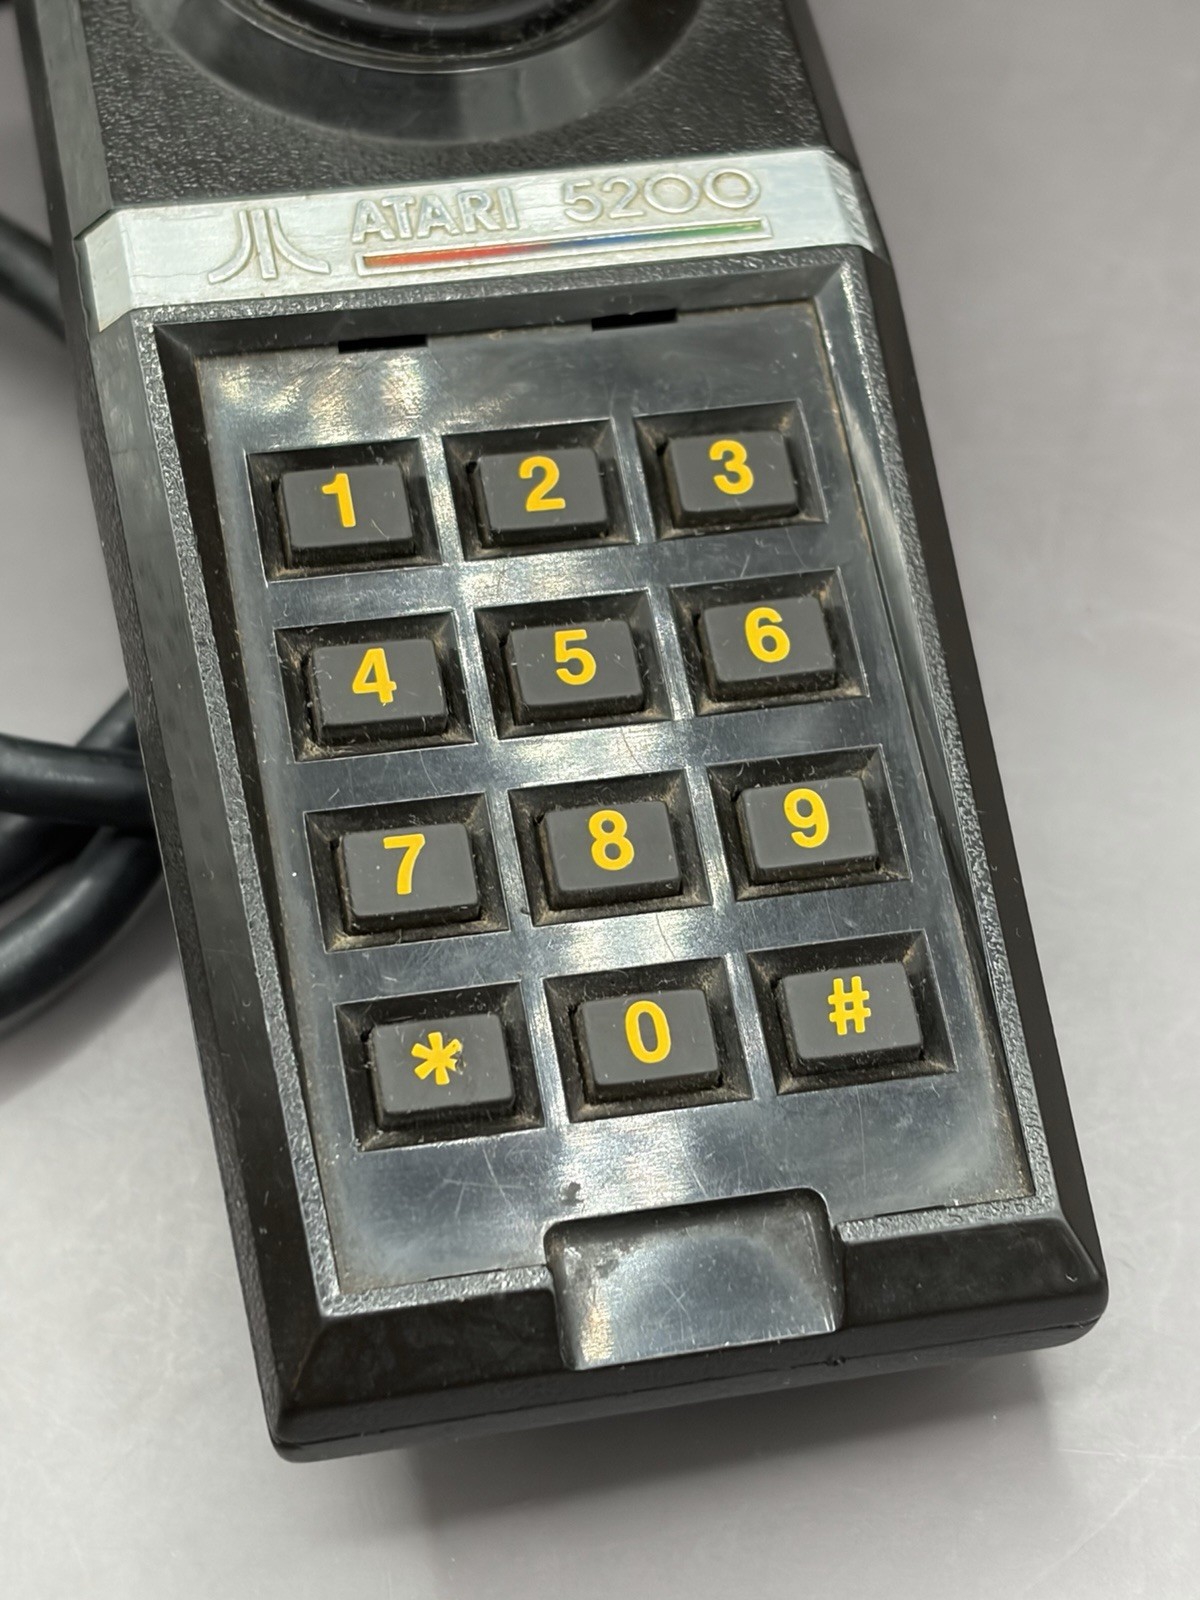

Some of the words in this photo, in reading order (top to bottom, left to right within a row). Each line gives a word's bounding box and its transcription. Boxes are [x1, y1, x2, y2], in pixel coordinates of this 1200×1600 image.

[352, 188, 519, 244] ATARI
[562, 168, 761, 222] 5200
[518, 455, 564, 511] 2
[708, 439, 752, 496] 3
[321, 472, 355, 527] 1
[553, 629, 595, 686] 5
[744, 607, 789, 663] 6
[351, 647, 395, 704] 4
[588, 809, 633, 870] 8
[783, 788, 828, 848] 9
[382, 833, 424, 895] 7
[624, 1000, 670, 1064] 0
[827, 976, 869, 1035] #
